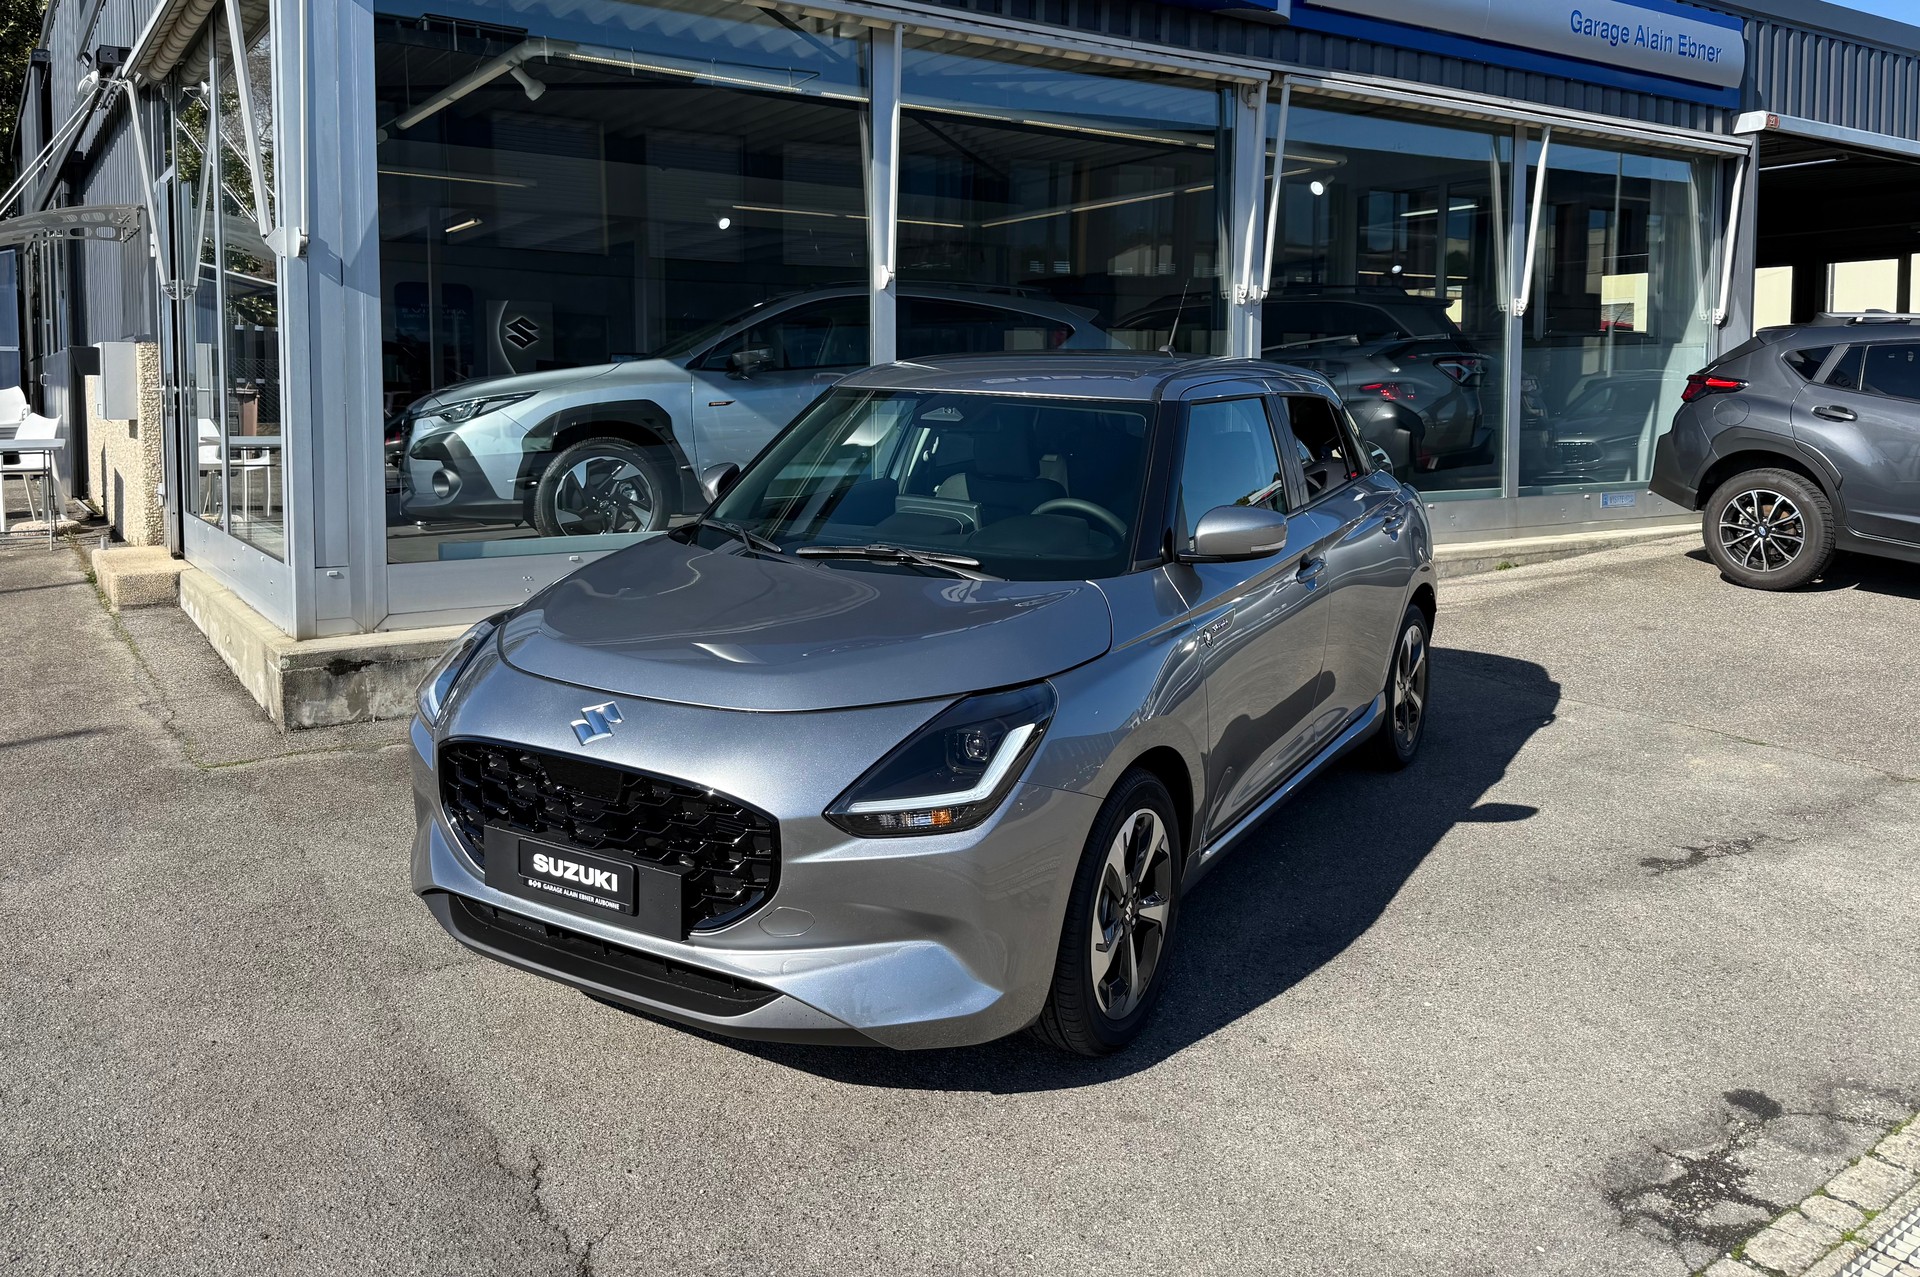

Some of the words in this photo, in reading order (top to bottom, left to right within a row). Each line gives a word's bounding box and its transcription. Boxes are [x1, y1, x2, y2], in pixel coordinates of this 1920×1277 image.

[1570, 9, 1630, 47] Garage
[1634, 24, 1673, 53] Alain
[1678, 34, 1722, 63] Ebner
[533, 853, 618, 892] SUZUKI
[543, 883, 563, 894] GARAGE
[563, 889, 579, 899] ALAIN
[579, 893, 595, 903] EBNER
[595, 897, 620, 910] AUBONNE
